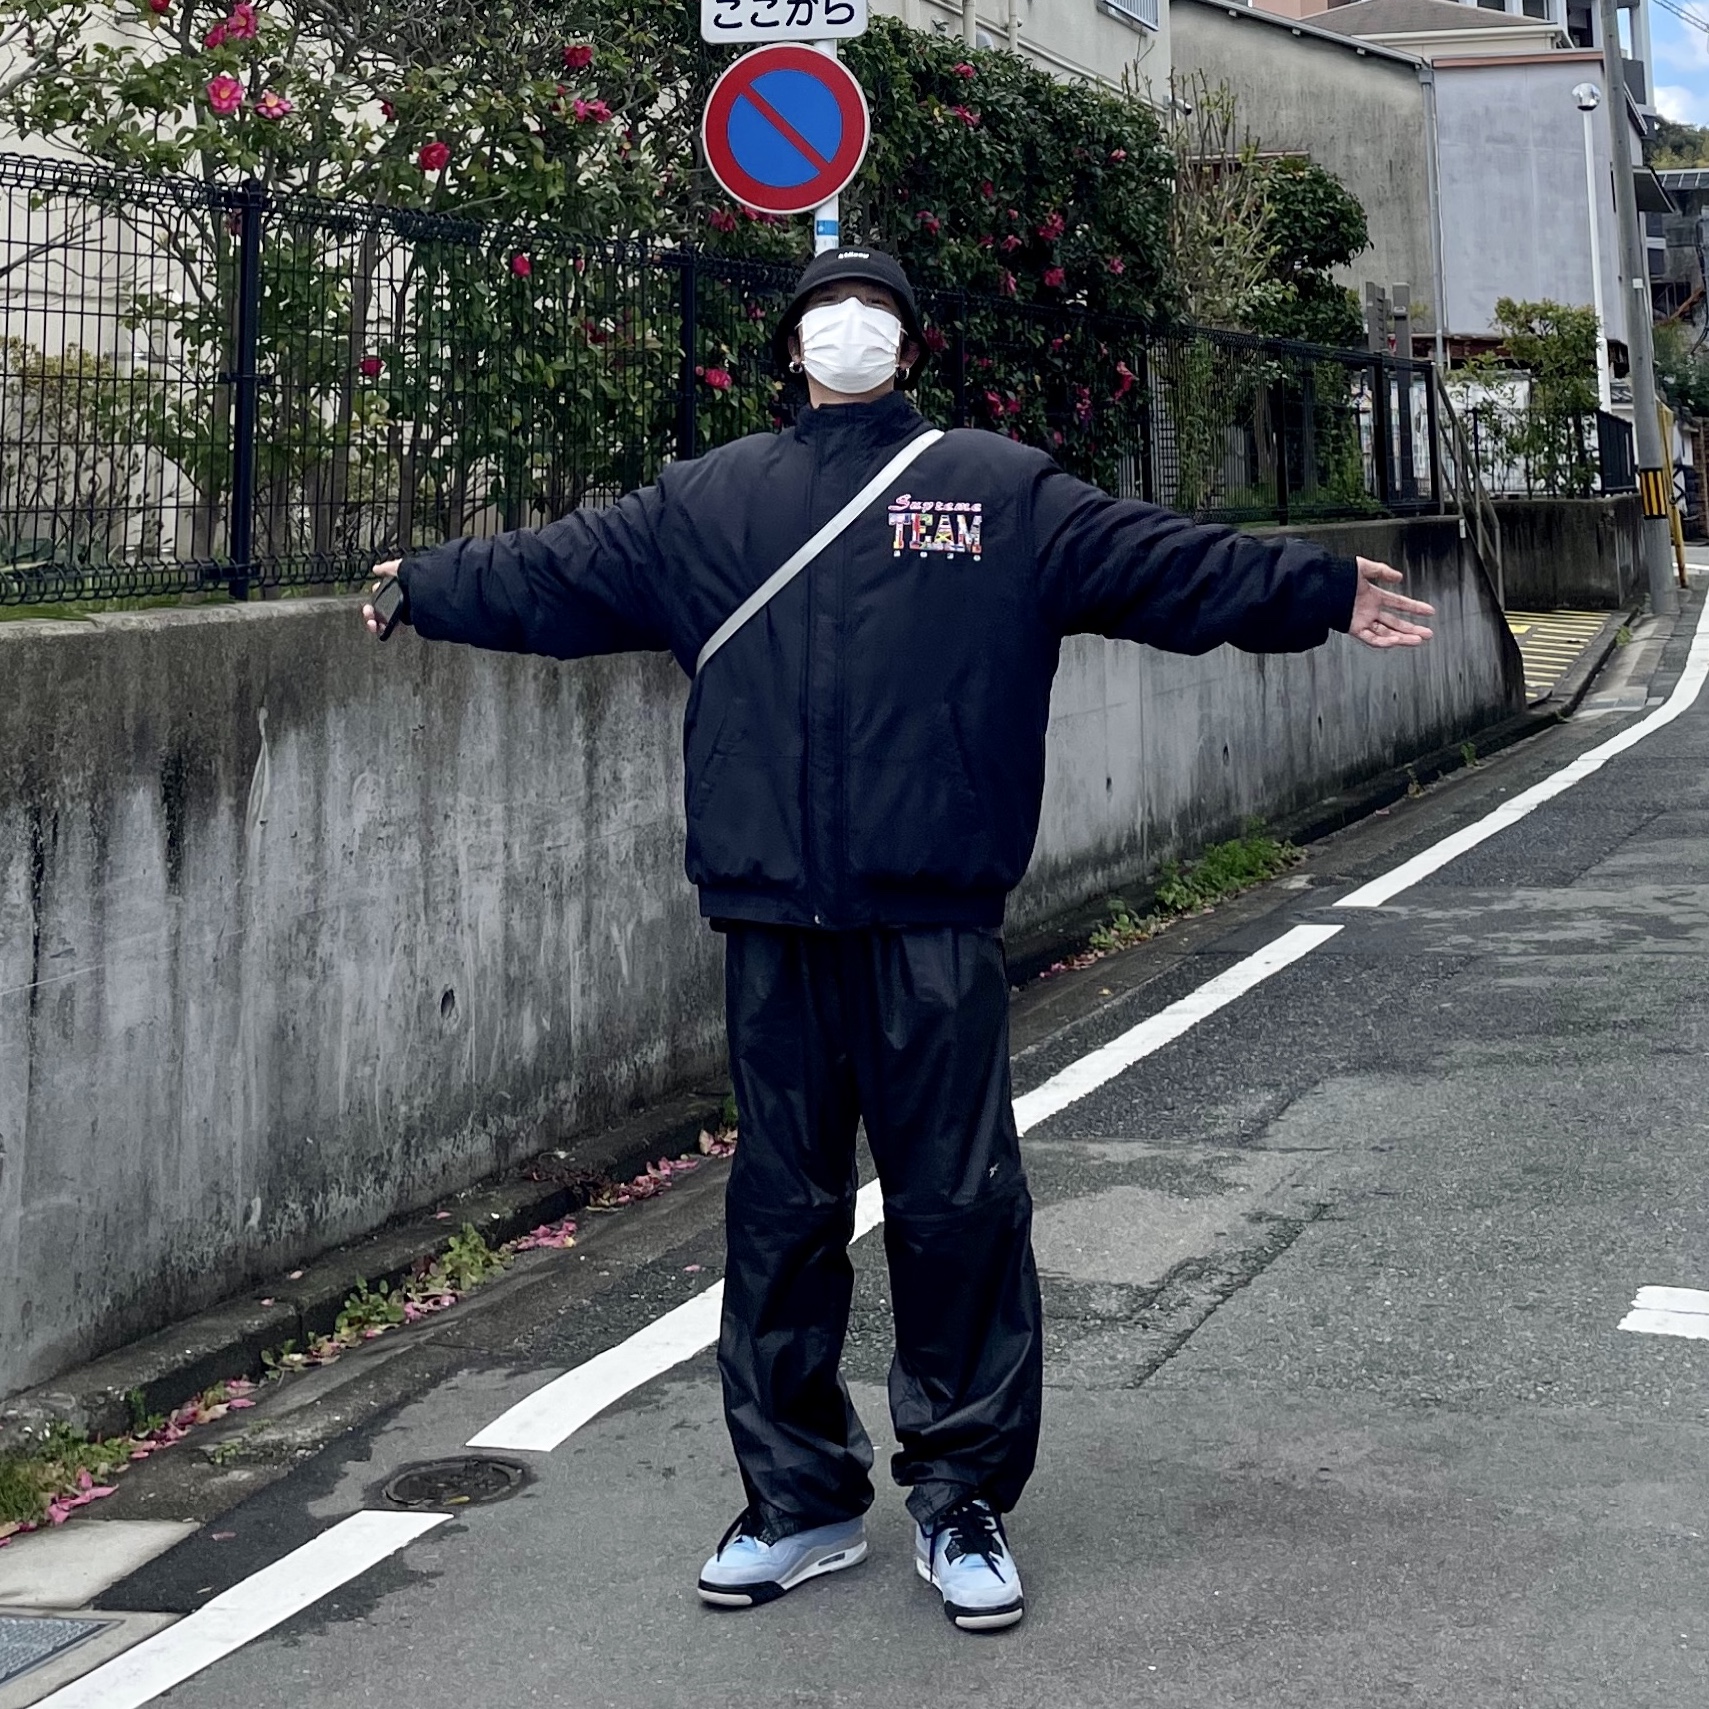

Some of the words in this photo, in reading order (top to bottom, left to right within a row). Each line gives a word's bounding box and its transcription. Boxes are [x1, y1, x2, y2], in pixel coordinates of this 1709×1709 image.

[713, 0, 855, 29] ここから
[888, 493, 982, 513] Supreme
[888, 513, 982, 553] TEAM
